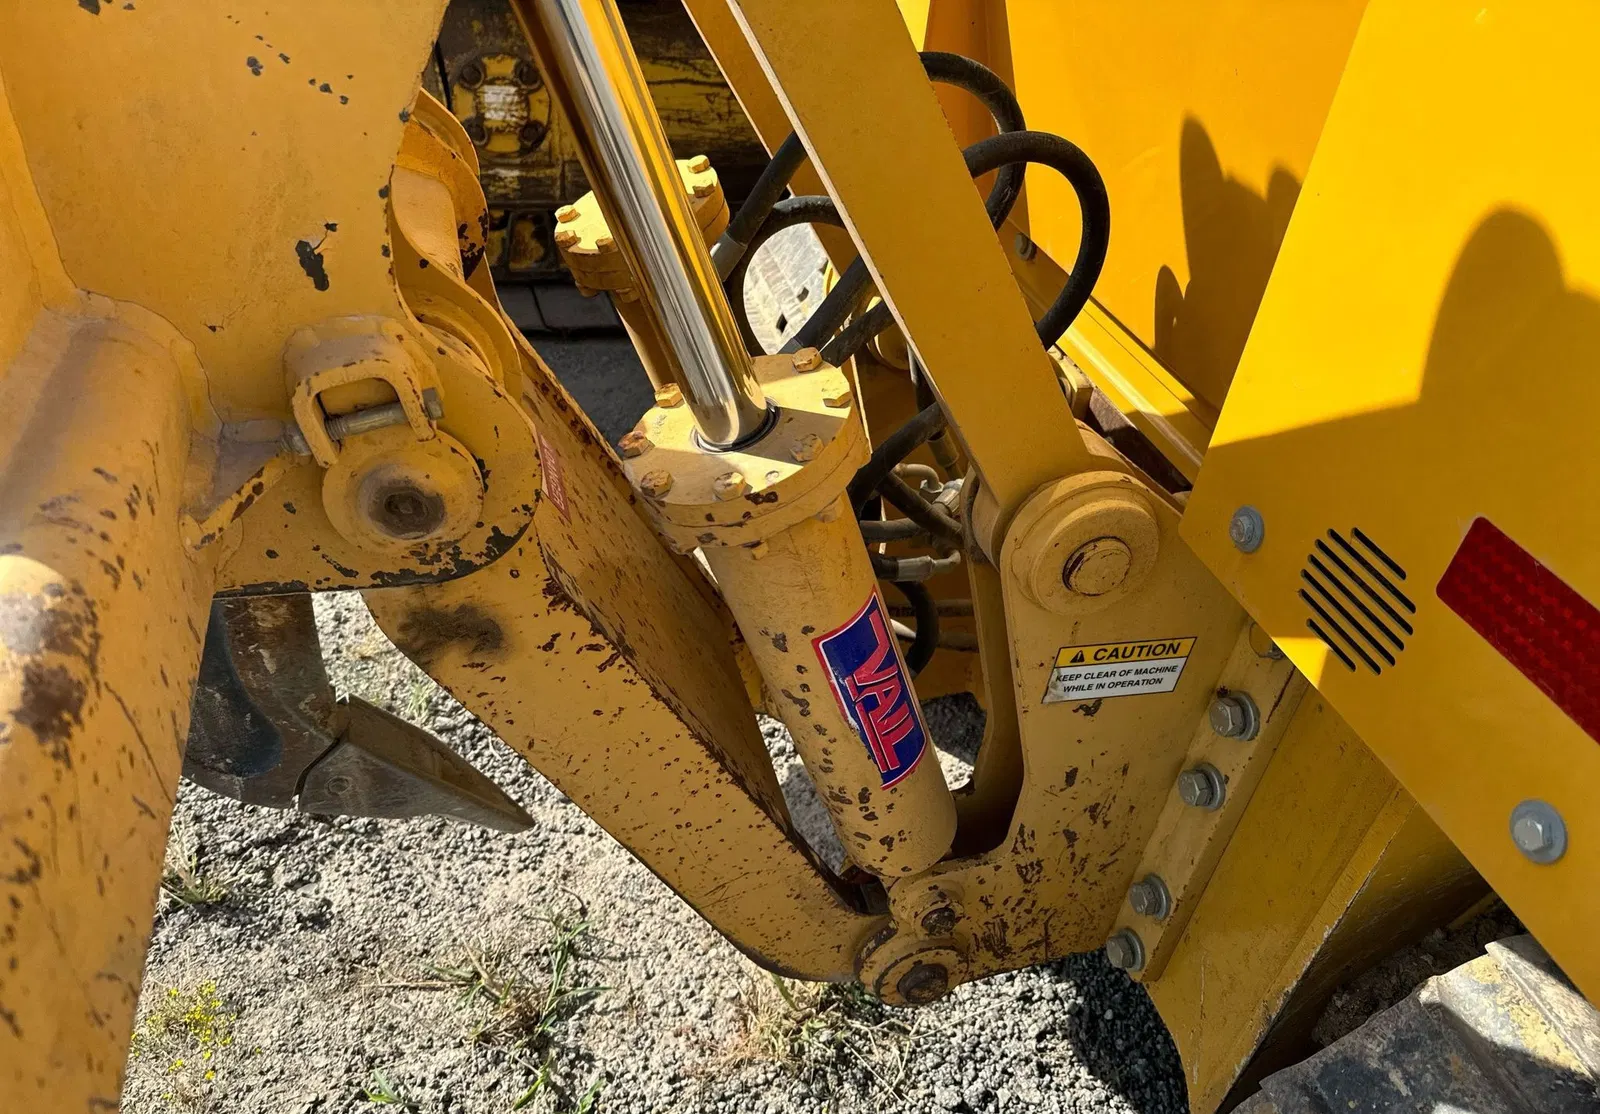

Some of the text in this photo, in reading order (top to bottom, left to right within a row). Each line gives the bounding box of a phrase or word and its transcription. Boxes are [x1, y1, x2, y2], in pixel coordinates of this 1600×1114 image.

[1094, 643, 1180, 661] CAUTION
[1056, 665, 1178, 682] KEEP CLEAR OF MACHINE
[845, 609, 915, 773] VAIL
[1063, 677, 1163, 693] WHILE IN OPERATION
